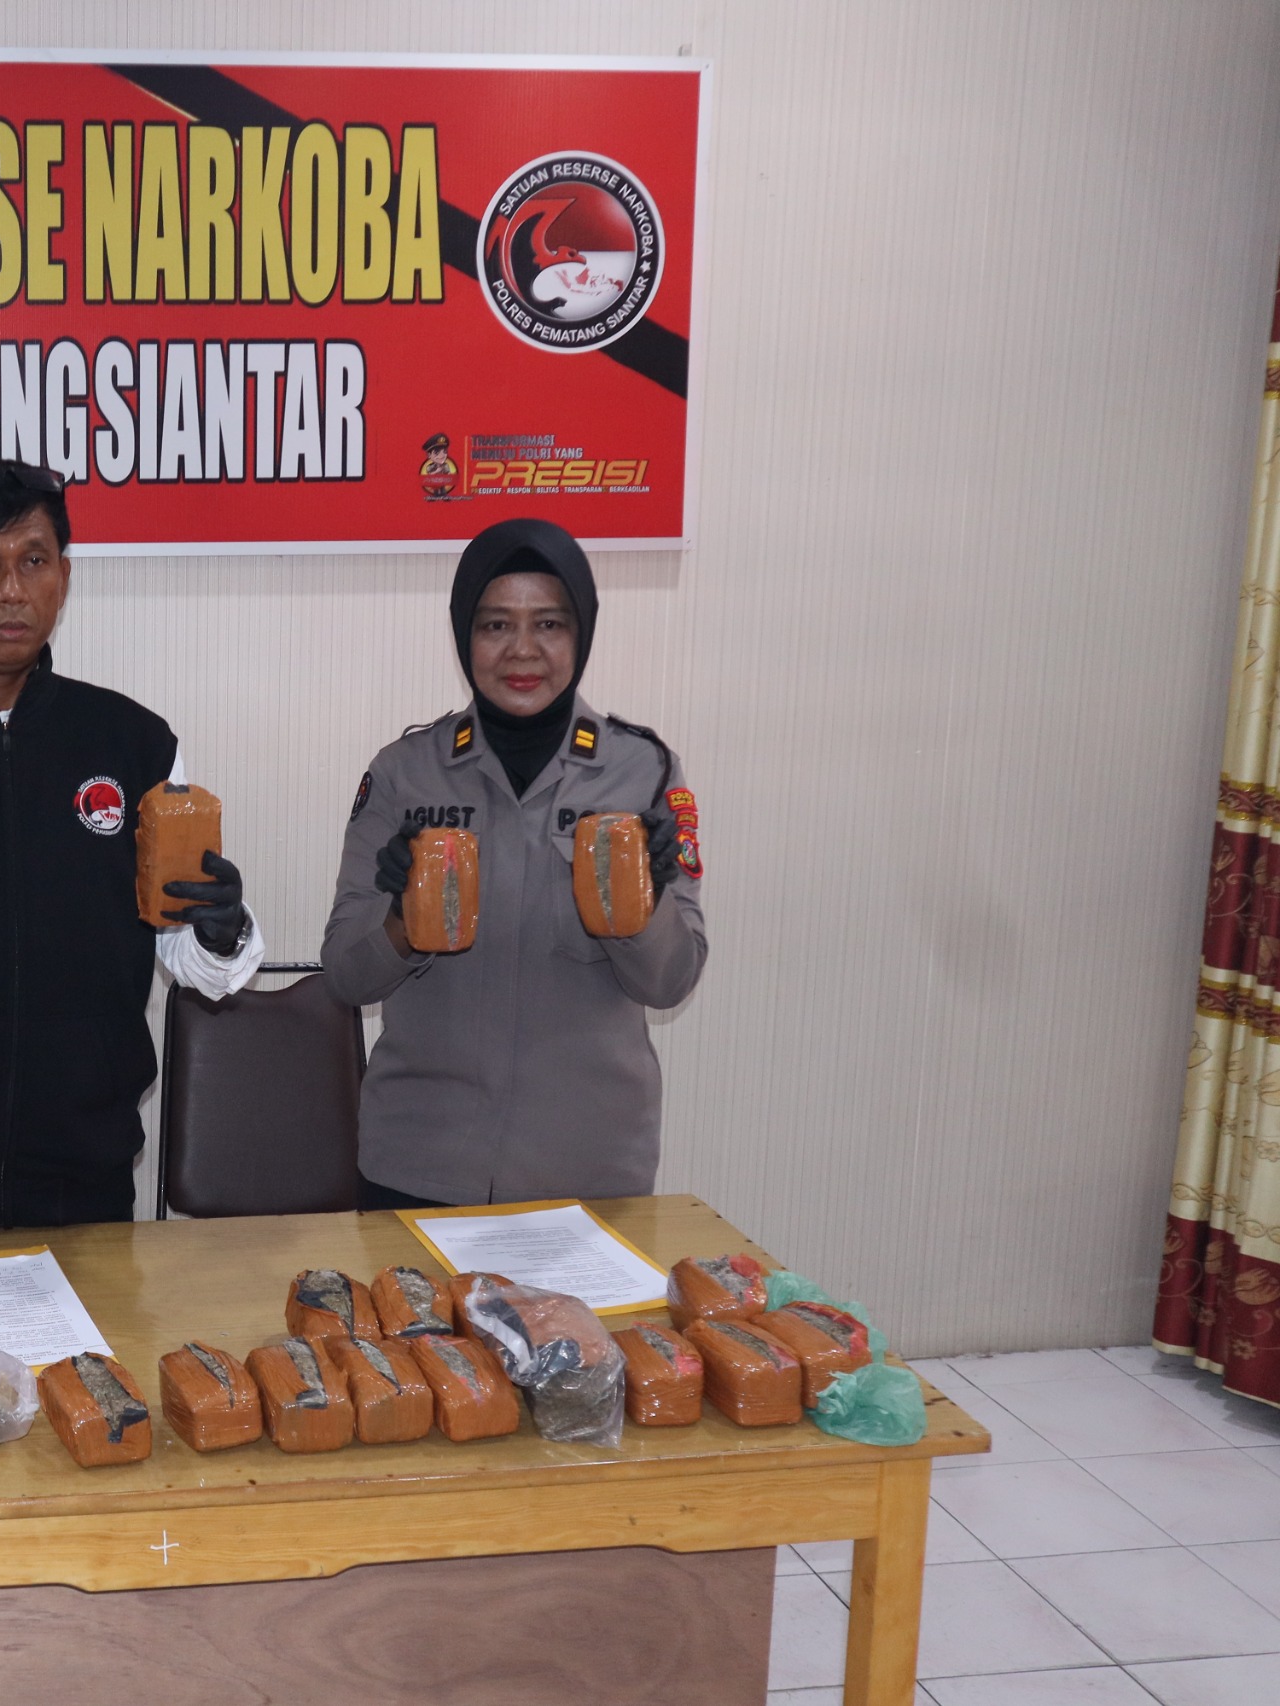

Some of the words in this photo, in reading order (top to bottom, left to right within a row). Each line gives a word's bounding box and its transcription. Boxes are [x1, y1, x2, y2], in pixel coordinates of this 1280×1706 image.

[83, 119, 445, 306] NARKOBA
[499, 168, 549, 216] SATUAN
[552, 162, 620, 189] RESERSE
[618, 183, 654, 257] NARKOBA
[492, 279, 532, 329] POLRES
[531, 322, 606, 343] PEMATANG
[608, 276, 649, 330] SIANTAR
[471, 460, 648, 486] PRESISI
[519, 447, 552, 460] POLRI
[554, 447, 583, 459] YANG
